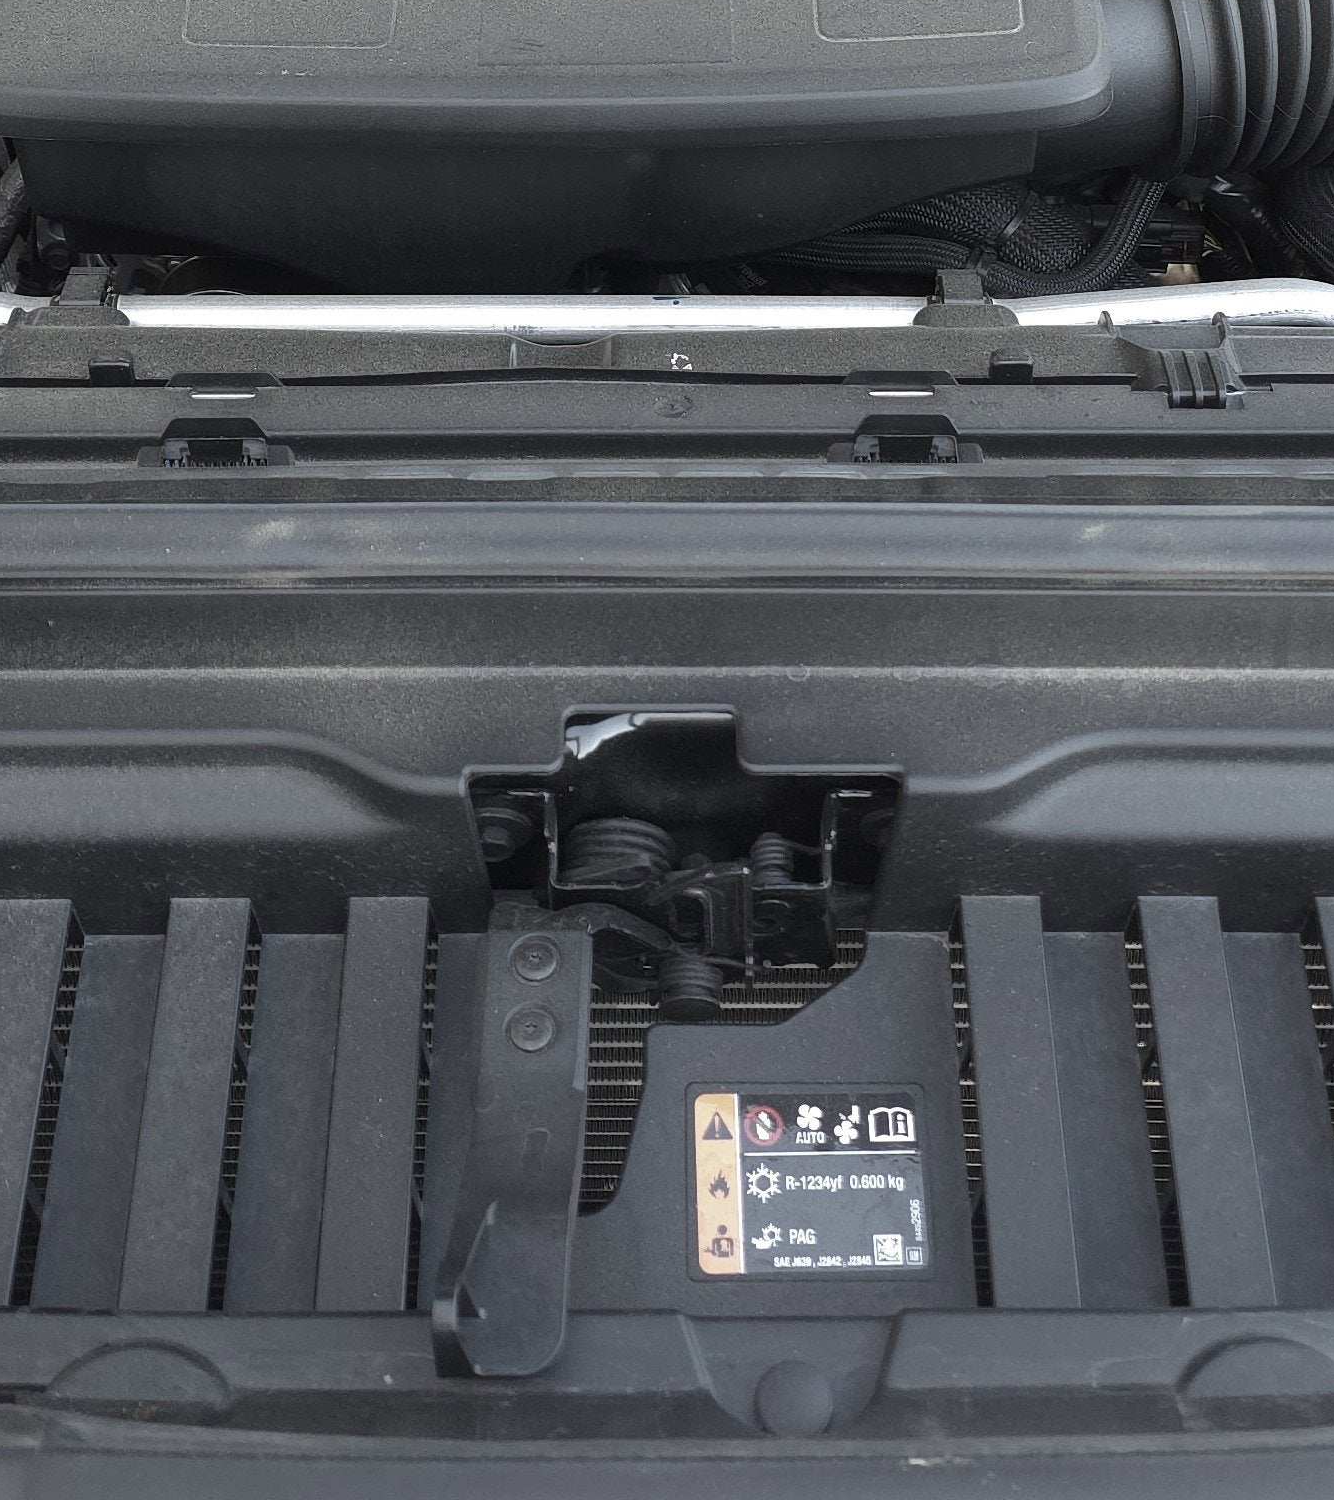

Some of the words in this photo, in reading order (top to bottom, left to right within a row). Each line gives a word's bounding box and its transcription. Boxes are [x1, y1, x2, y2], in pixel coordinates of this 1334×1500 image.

[796, 1131, 825, 1144] AUTO
[785, 1175, 843, 1192] R-1234yf
[849, 1174, 885, 1189] 0.600
[887, 1174, 905, 1191] kg
[788, 1228, 817, 1245] PAG
[773, 1256, 791, 1267] SAE
